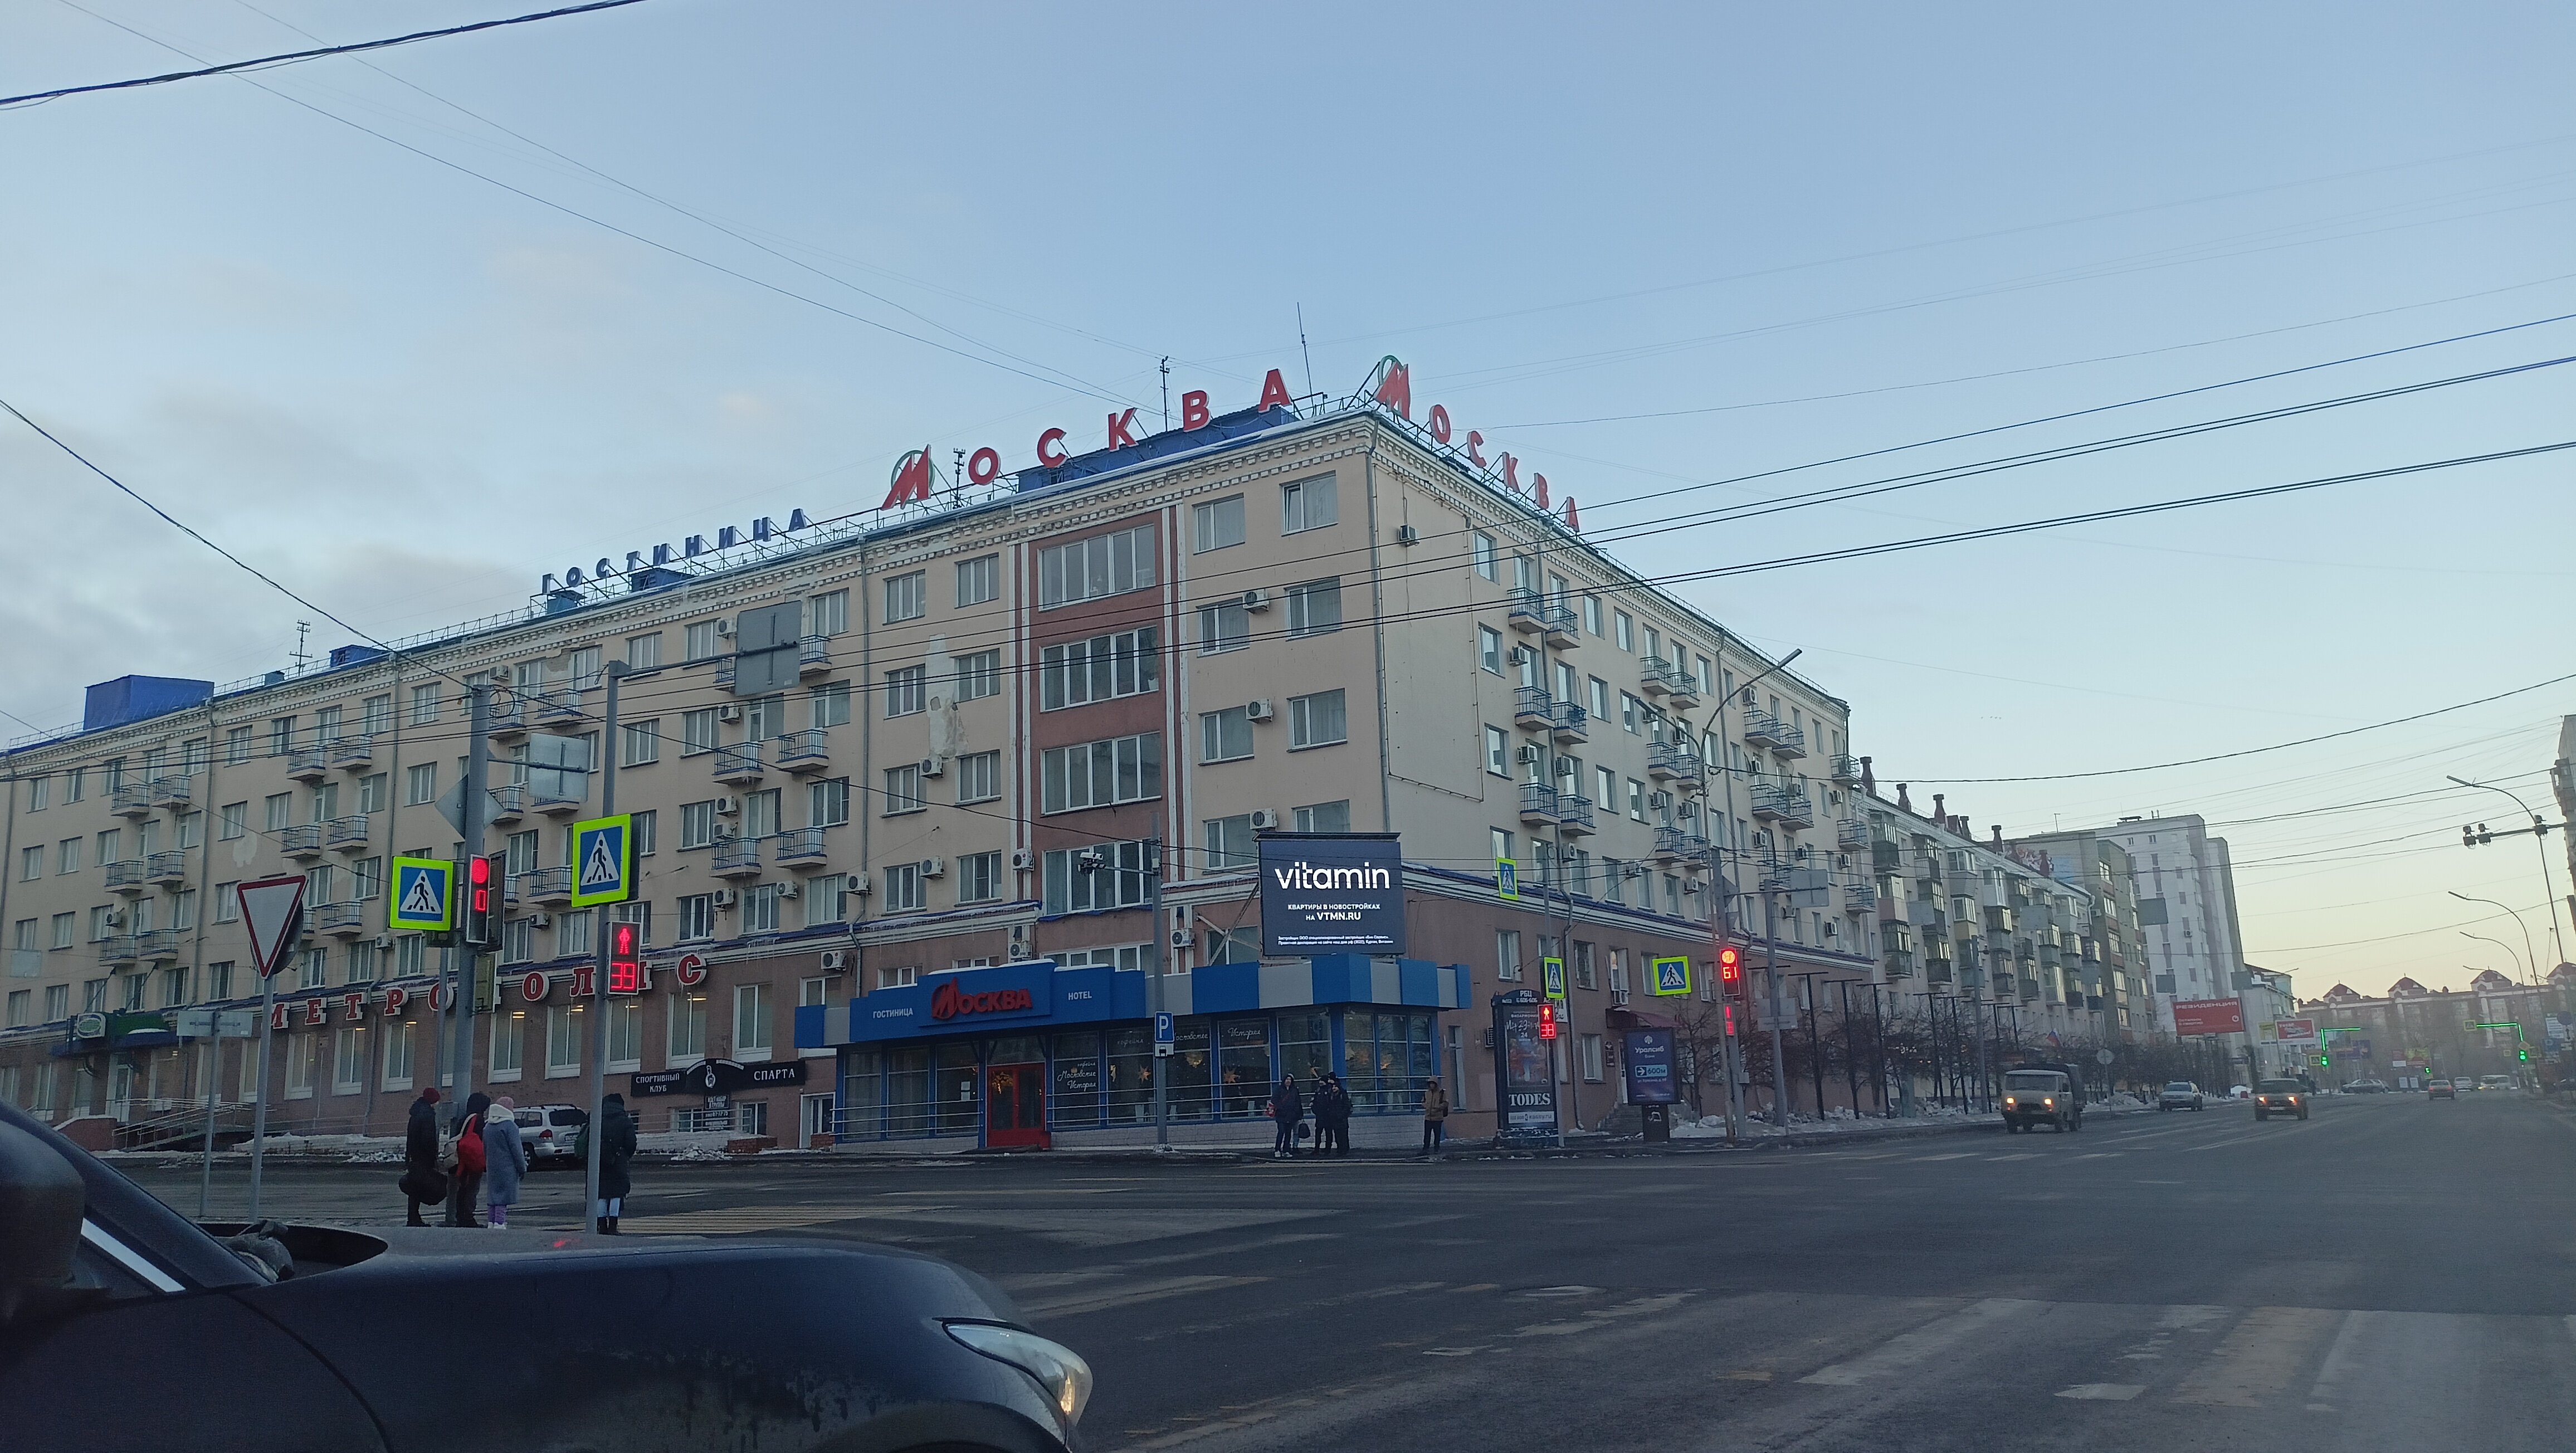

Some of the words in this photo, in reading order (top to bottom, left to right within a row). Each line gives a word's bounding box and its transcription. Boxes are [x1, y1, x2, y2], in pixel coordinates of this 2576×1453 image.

[881, 368, 1292, 510] МОСКВА
[1373, 355, 1580, 533] МОСКВА
[542, 508, 807, 594] ГОСТИНИЦА
[1275, 861, 1390, 889] vitamin
[1316, 911, 1361, 920] VTMN.RU
[611, 962, 636, 990] 39
[1723, 966, 1738, 979] 61
[931, 977, 1033, 1019] МОСКВА
[1067, 991, 1092, 1001] HOTEL
[2175, 1001, 2238, 1010] РЕЗИДЕНЦИЯ
[872, 1007, 914, 1019] ГОСТИНИЦА
[1159, 1015, 1169, 1038] P
[1541, 1023, 1554, 1037] 38
[1175, 1031, 1208, 1041] осковские
[1635, 1045, 1665, 1054] Уралсиб
[753, 1067, 796, 1081] СПАРТА
[649, 1084, 667, 1093] КЛУБ
[1508, 1093, 1551, 1106] TODES
